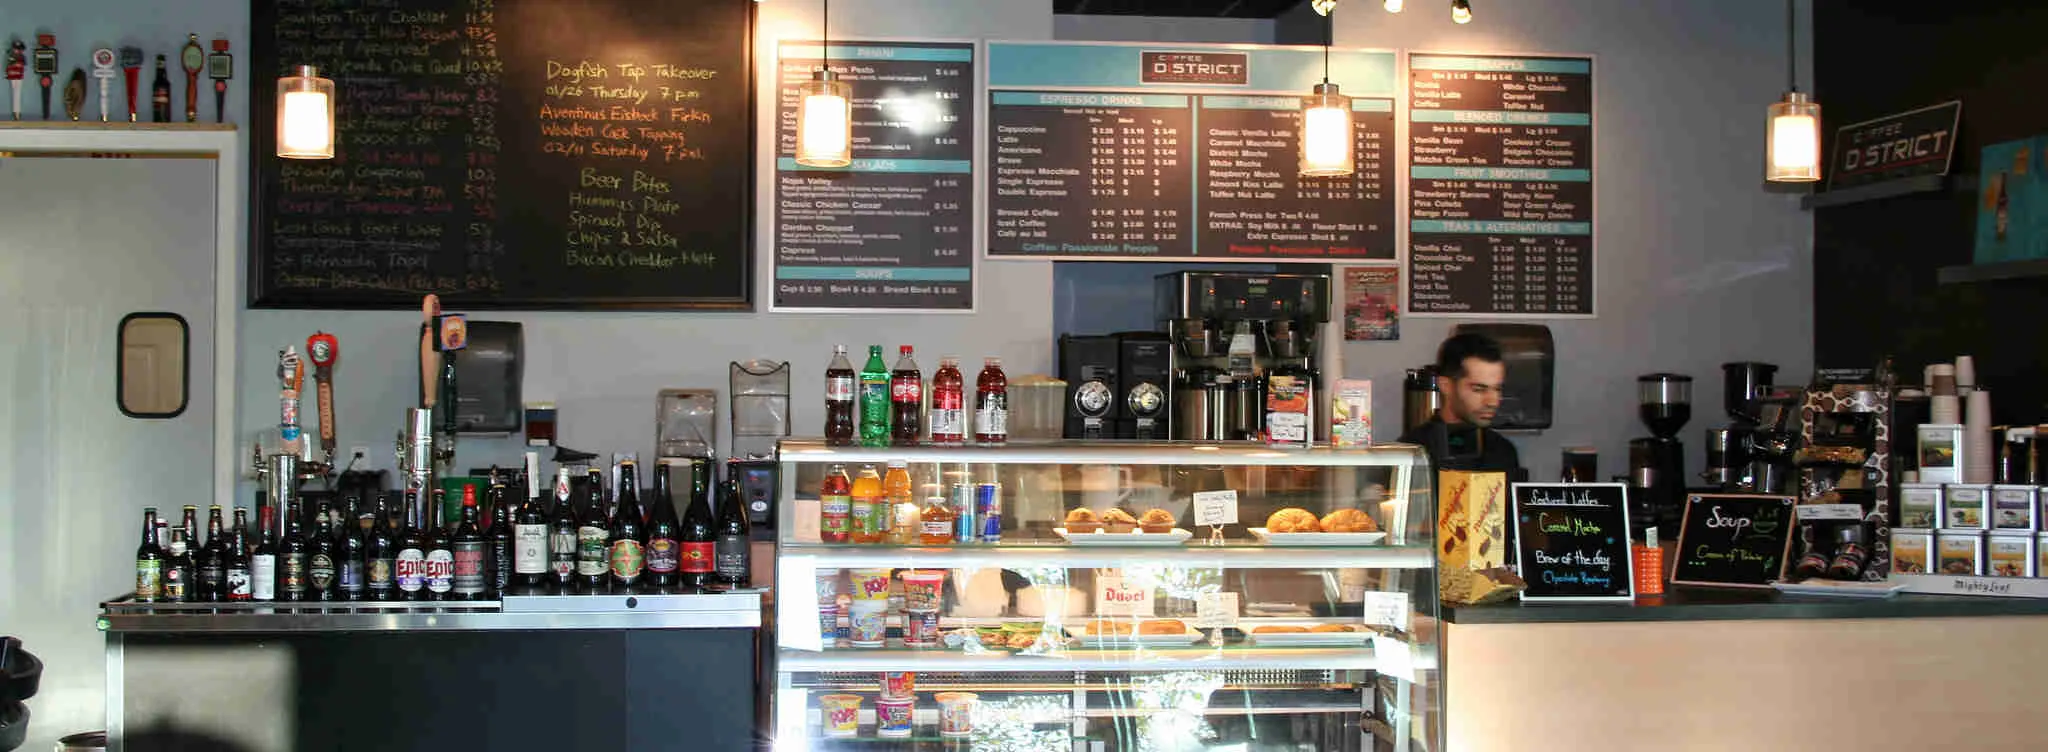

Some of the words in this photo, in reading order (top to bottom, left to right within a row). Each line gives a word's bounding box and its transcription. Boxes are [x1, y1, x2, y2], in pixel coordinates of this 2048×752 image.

[546, 59, 609, 84] Dogfish
[617, 63, 646, 84] Tap
[652, 64, 718, 82] Takeover
[1153, 63, 1242, 75] DISTRICT
[589, 85, 649, 105] Thursday
[1844, 130, 1949, 171] DISTRICT
[581, 167, 622, 189] Beer
[632, 170, 674, 193] Bites
[815, 201, 850, 211] Chicken
[570, 210, 626, 229] Spinach
[636, 213, 662, 231] Dip
[636, 230, 678, 249] Salsa
[1706, 505, 1752, 541] Soup
[1575, 549, 1591, 565] the
